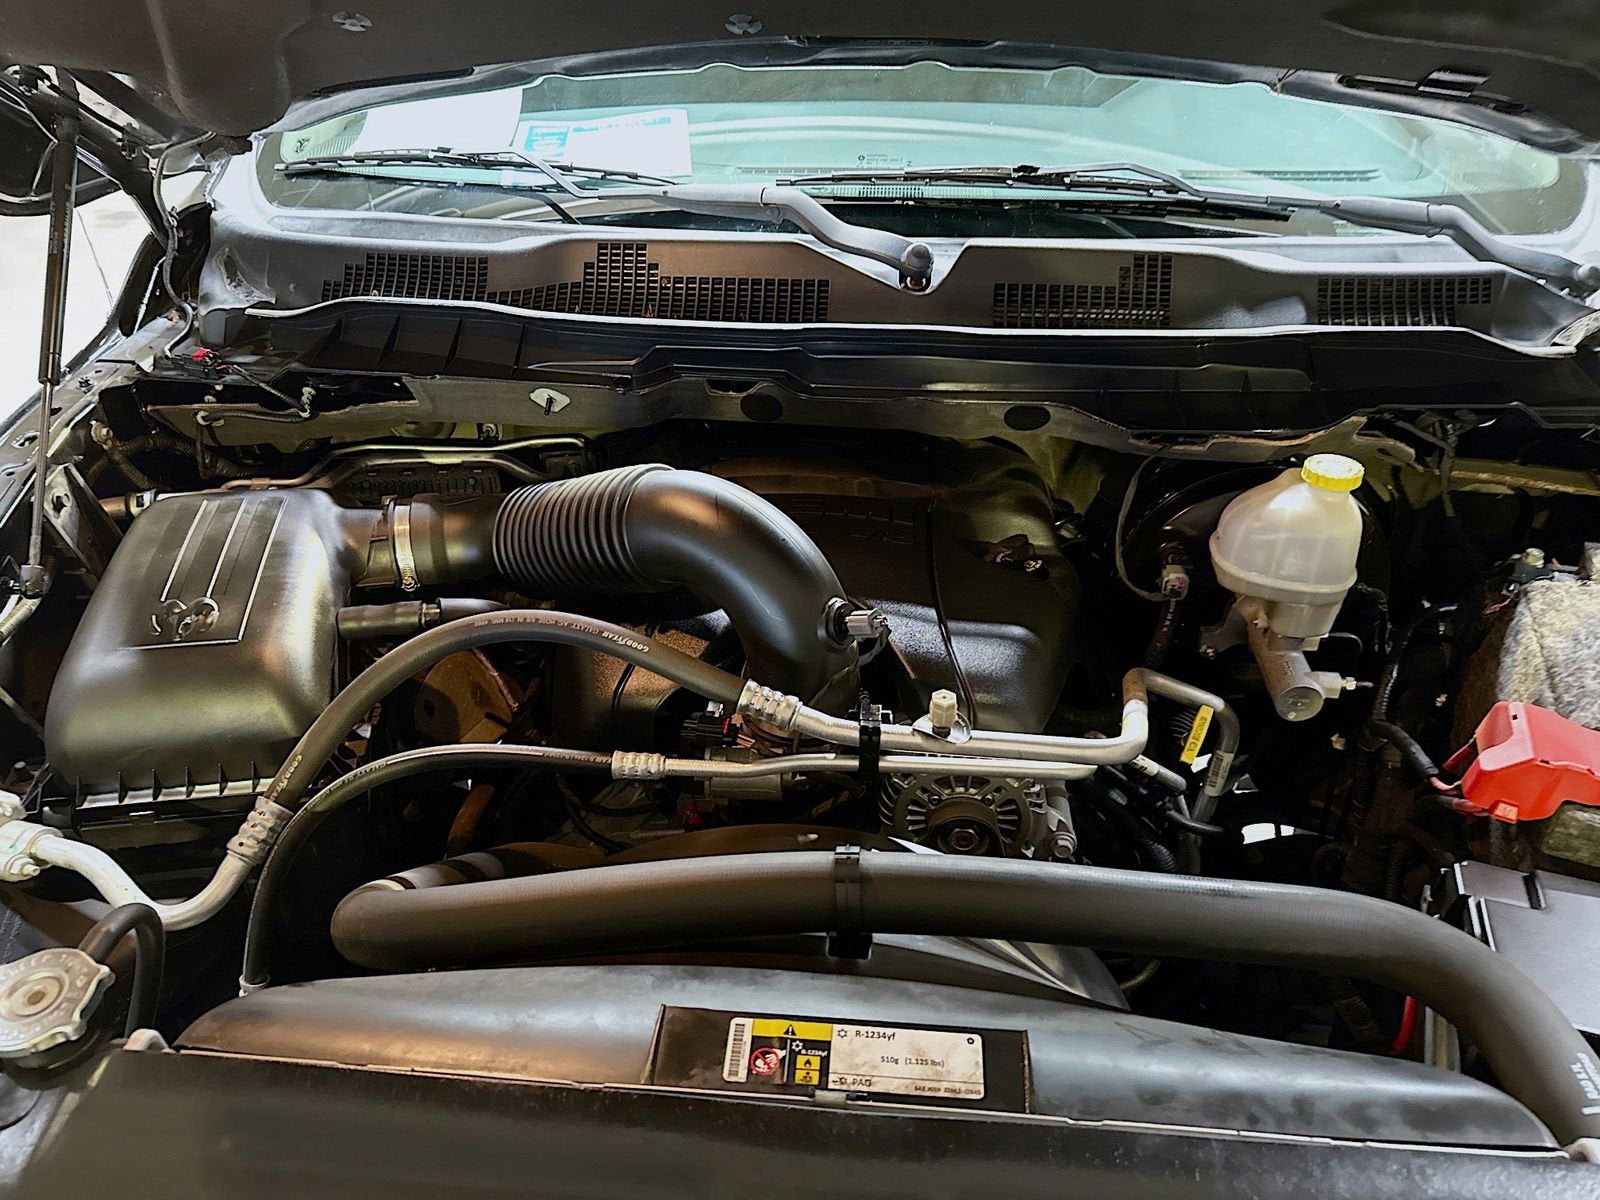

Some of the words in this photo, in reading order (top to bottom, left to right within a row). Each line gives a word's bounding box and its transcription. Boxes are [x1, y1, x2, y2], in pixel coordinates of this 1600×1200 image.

[571, 624, 600, 635] GALAXY
[601, 630, 650, 653] GOODYEAR
[855, 1030, 896, 1042] R-1234yf
[880, 1056, 899, 1065] 510g
[904, 1056, 929, 1066] (1.125
[930, 1058, 945, 1068] lbs)
[851, 1077, 872, 1087] PAG
